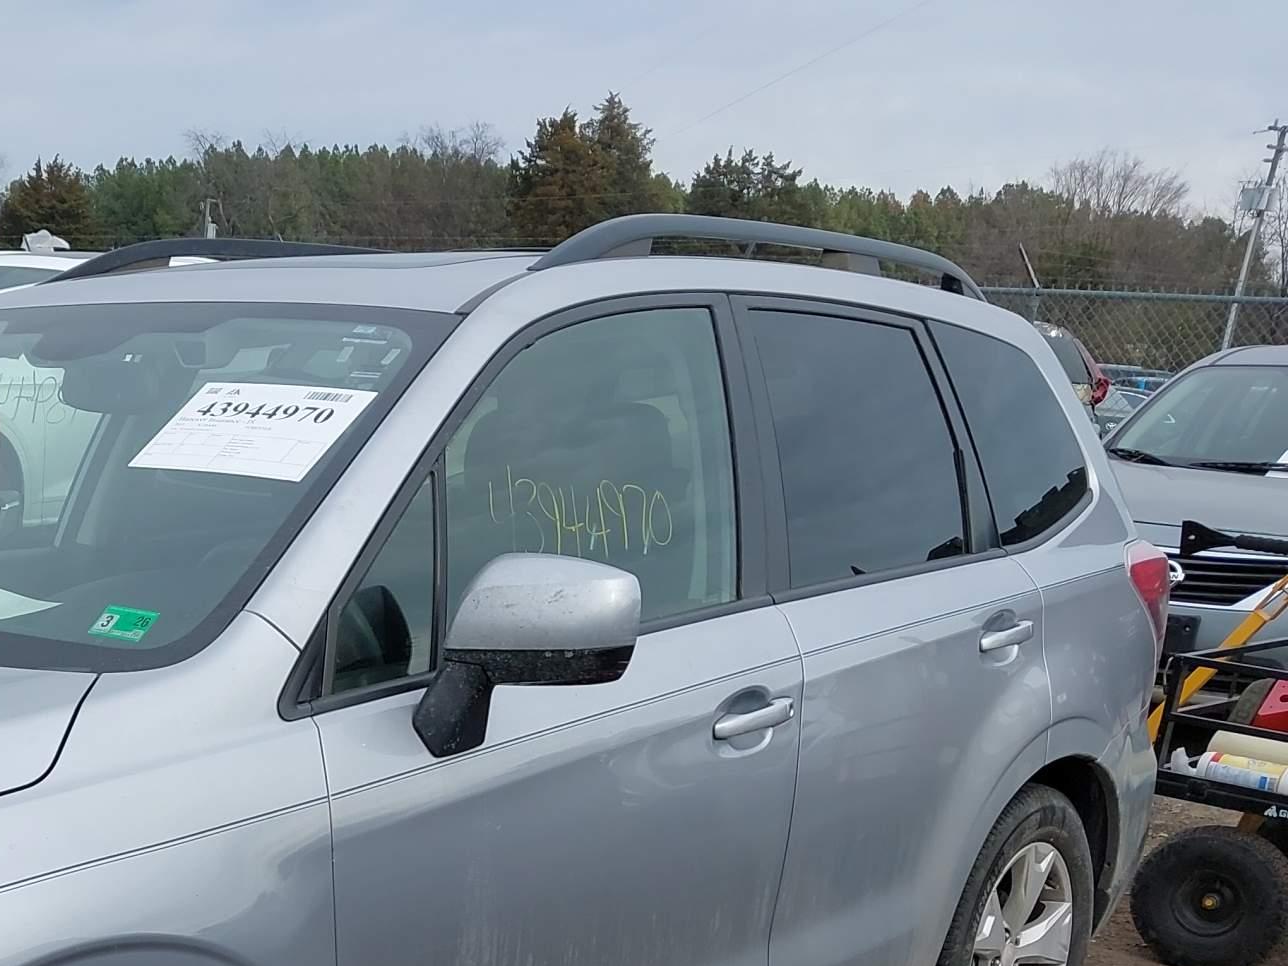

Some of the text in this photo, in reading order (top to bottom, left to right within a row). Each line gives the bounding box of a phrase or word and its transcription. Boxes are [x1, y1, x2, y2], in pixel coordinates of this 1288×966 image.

[196, 401, 335, 424] 43944970
[101, 615, 114, 628] 3
[133, 616, 152, 628] 26
